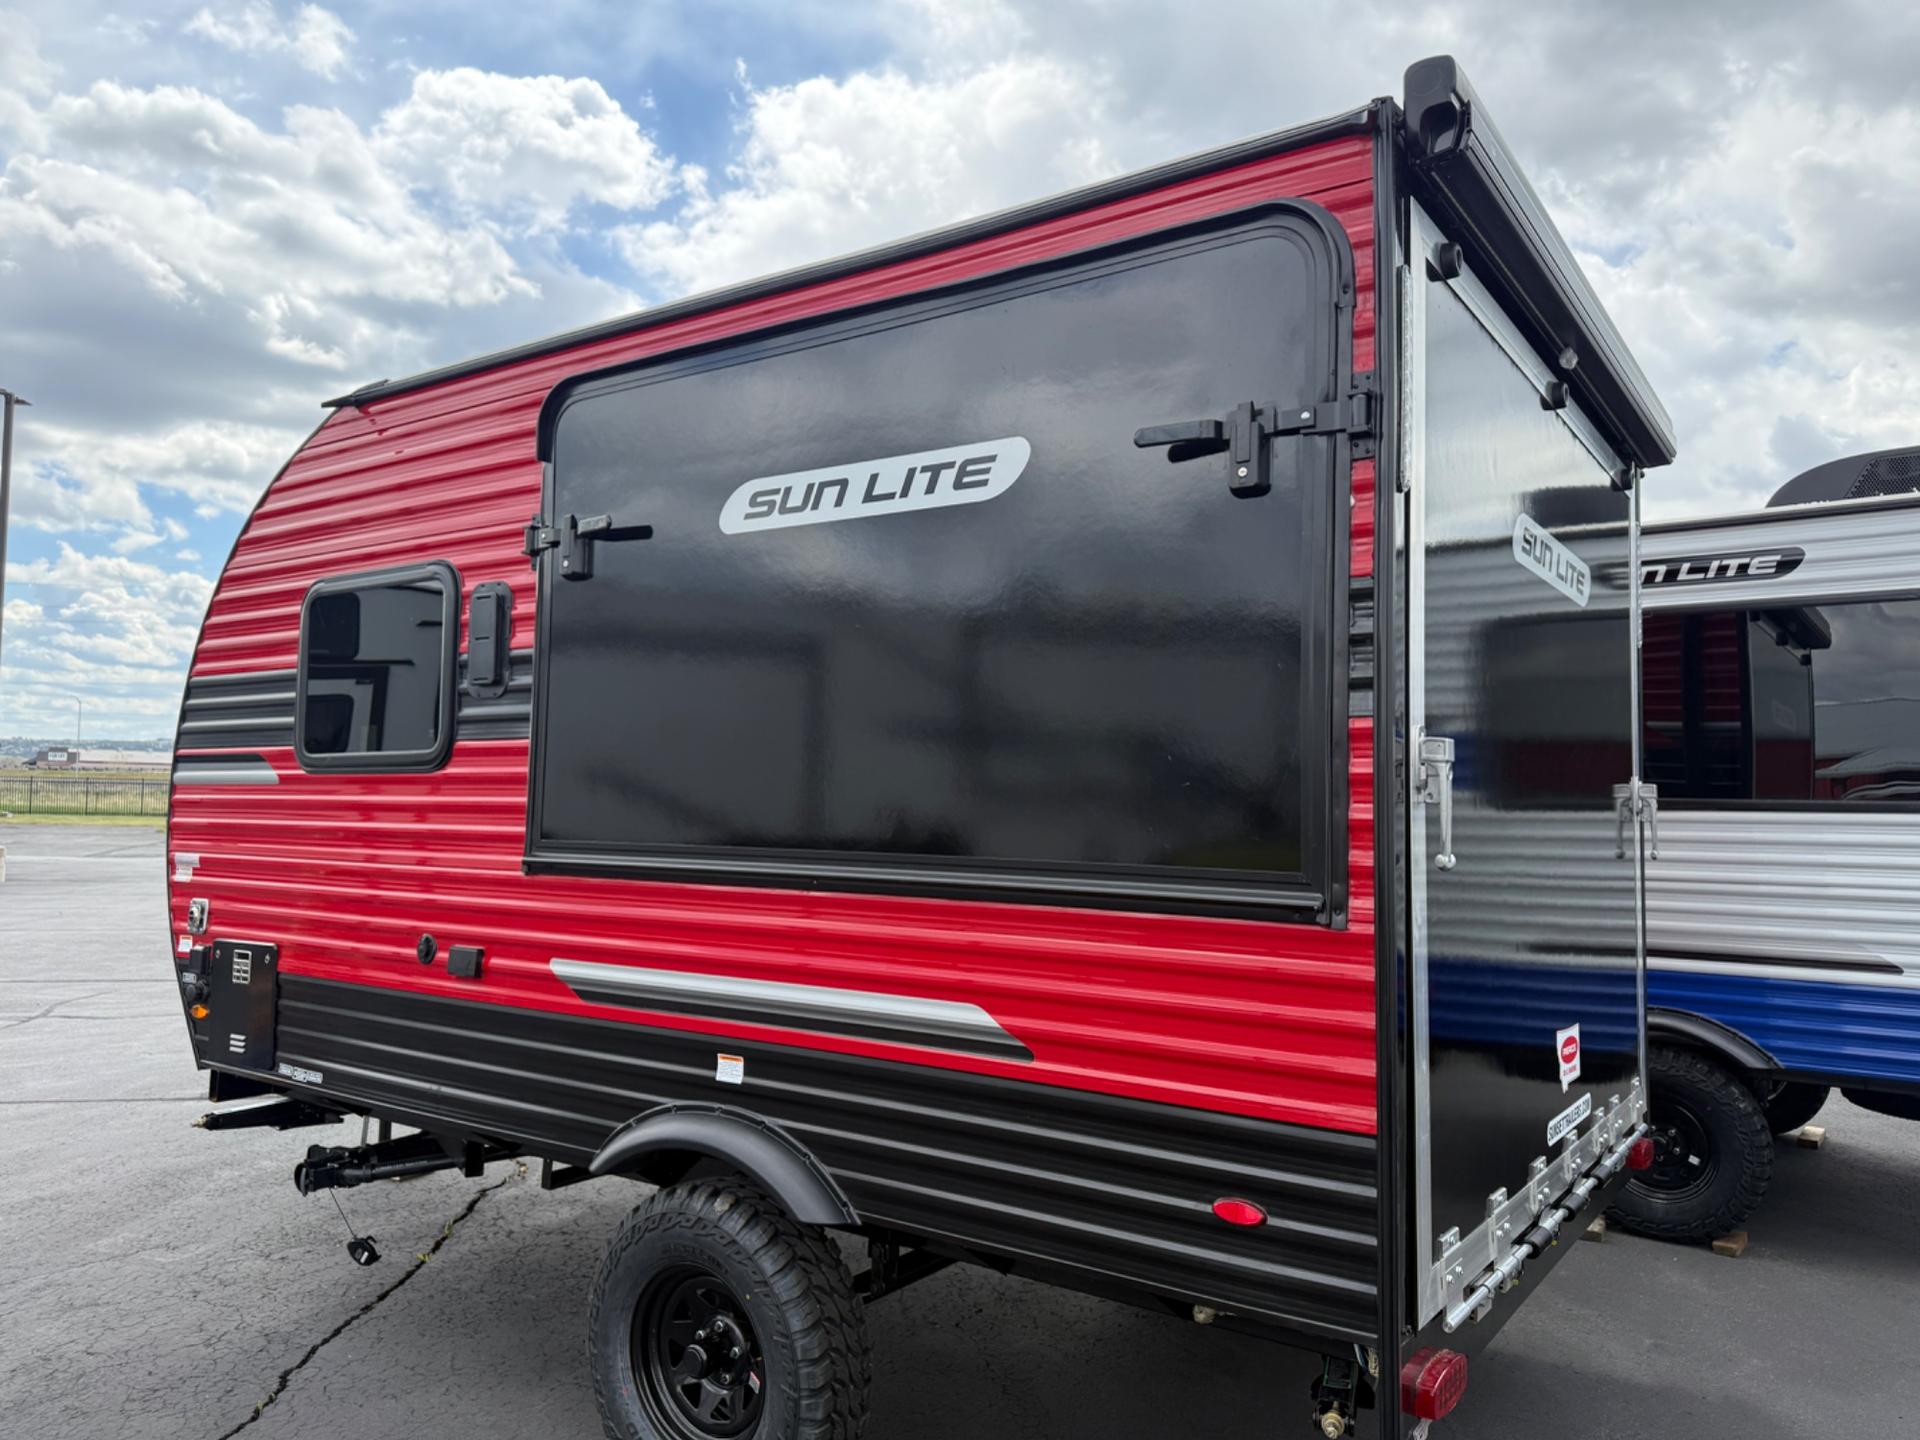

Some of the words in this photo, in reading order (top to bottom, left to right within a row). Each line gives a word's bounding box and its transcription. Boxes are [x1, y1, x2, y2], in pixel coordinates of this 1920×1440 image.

[743, 477, 849, 521] SUN
[861, 454, 998, 504] LITE
[1521, 526, 1553, 573] SUN
[1556, 552, 1586, 596] LITE
[1676, 554, 1782, 581] LITE
